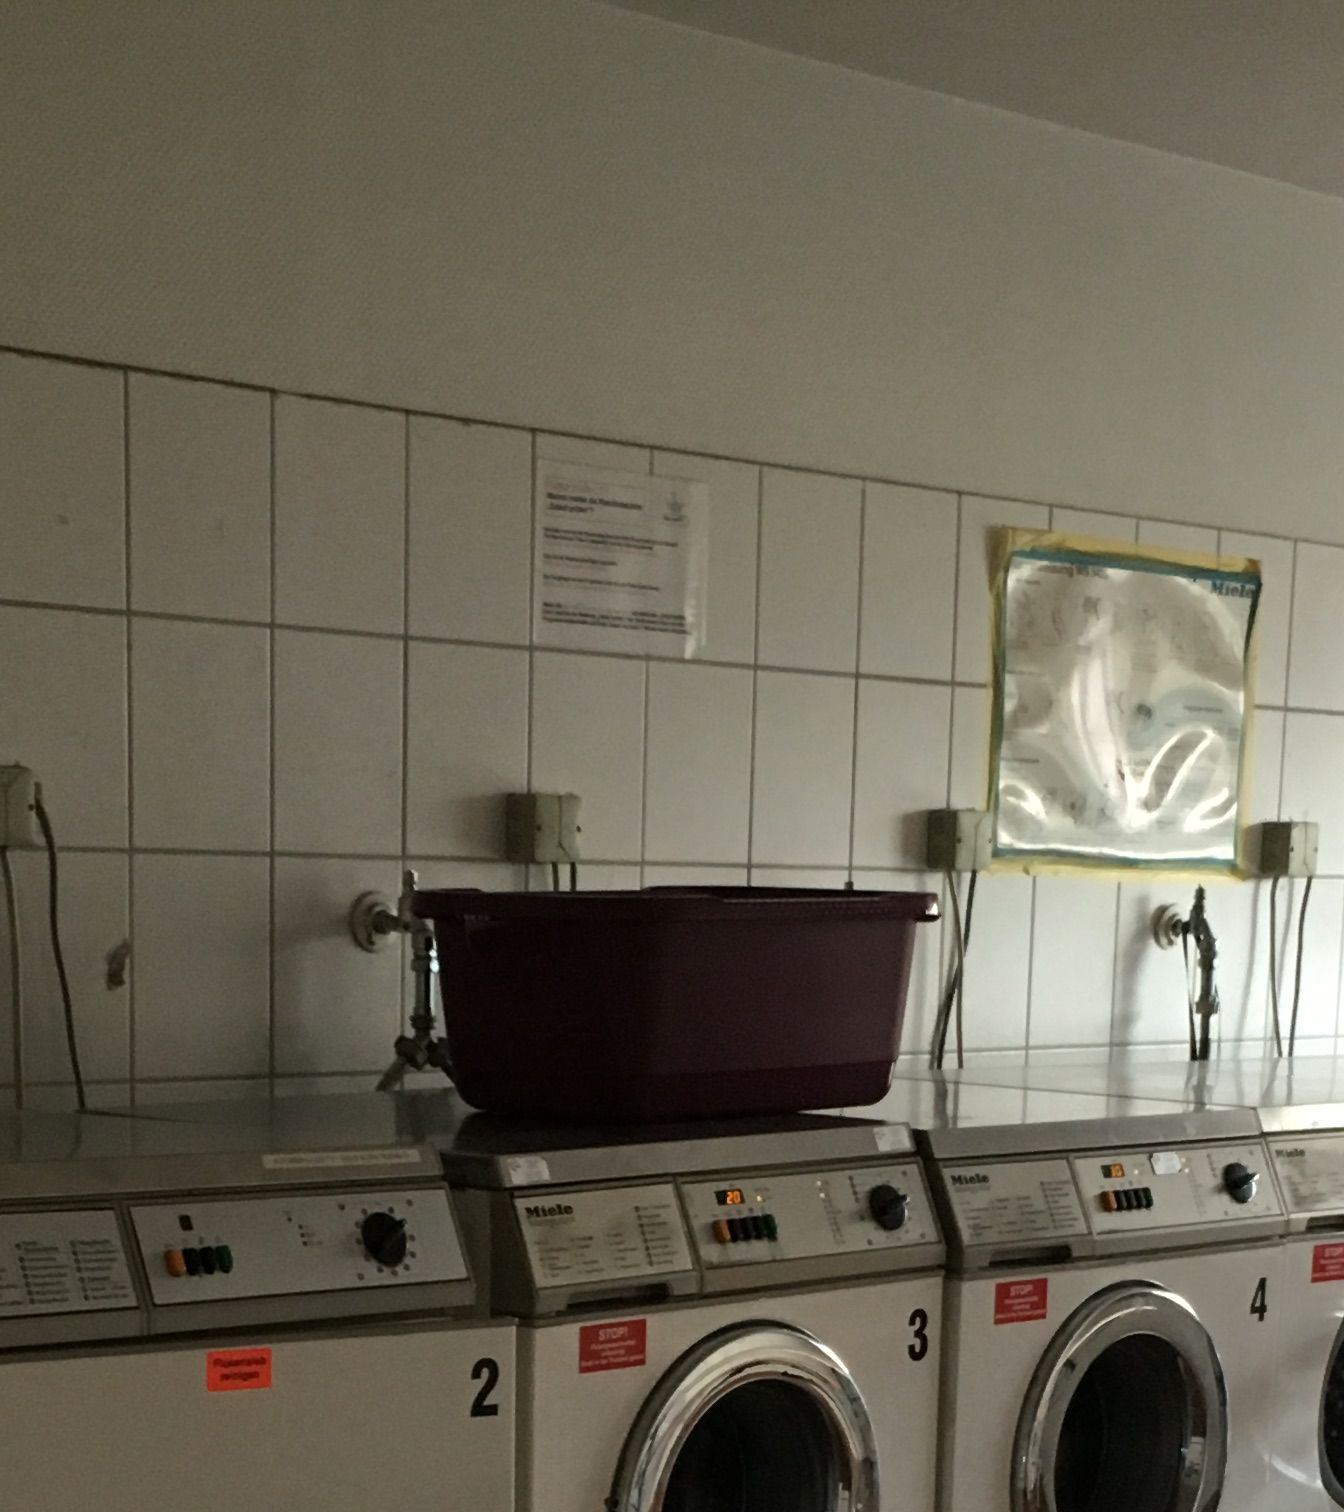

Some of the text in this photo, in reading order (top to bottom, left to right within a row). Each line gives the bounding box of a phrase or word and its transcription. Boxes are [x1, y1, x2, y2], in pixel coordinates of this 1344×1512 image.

[950, 1173, 990, 1186] Miele
[524, 1204, 574, 1218] Miele
[726, 1190, 741, 1205] 20
[1249, 1277, 1268, 1322] 4
[907, 1308, 928, 1361] 3
[470, 1358, 499, 1418] 2
